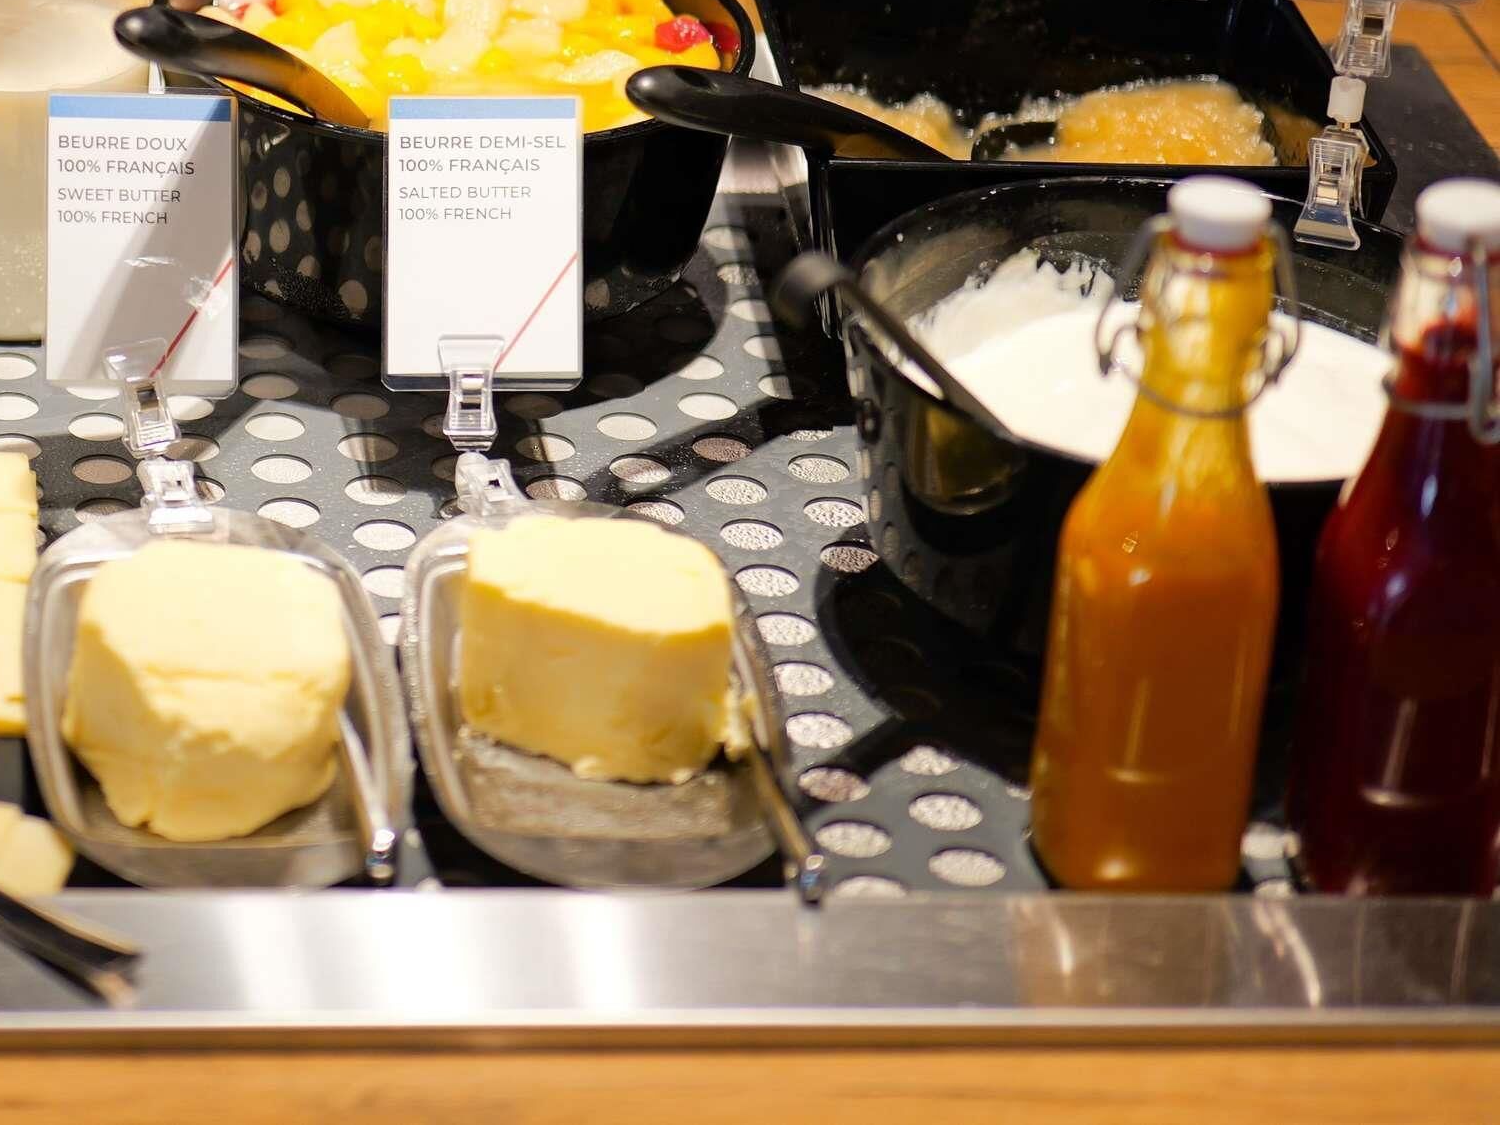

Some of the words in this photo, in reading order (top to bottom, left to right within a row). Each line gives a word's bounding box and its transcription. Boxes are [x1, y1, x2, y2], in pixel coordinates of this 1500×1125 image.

[59, 136, 130, 149] BEURRE
[136, 138, 187, 150] DOUX
[400, 136, 473, 148] BEURRE
[480, 136, 566, 148] DEMI-SEL
[58, 159, 100, 172] 100%
[106, 160, 194, 177] FRANÇAIS
[399, 159, 443, 172] 100%
[450, 159, 540, 175] FRANÇAIS
[58, 188, 113, 201] SWEET
[119, 189, 180, 202] BUTTER
[399, 187, 462, 199] SALTED
[468, 187, 531, 198] BUTTER
[58, 211, 97, 222] 100%
[102, 211, 167, 224] FRENCH
[399, 208, 438, 220] 100%
[444, 208, 511, 219] FRENCH
